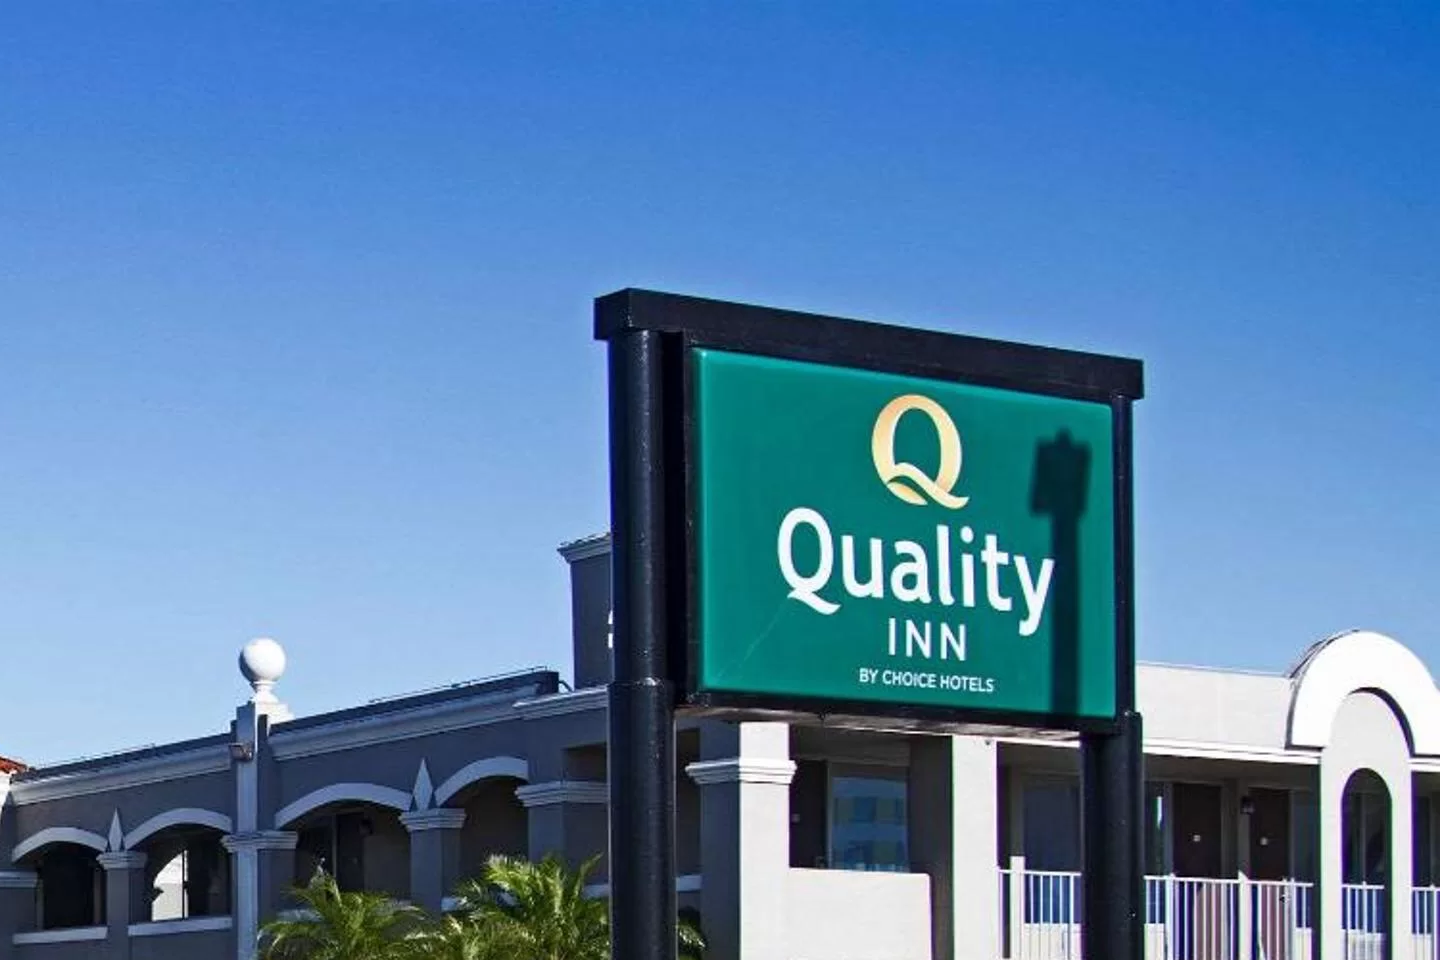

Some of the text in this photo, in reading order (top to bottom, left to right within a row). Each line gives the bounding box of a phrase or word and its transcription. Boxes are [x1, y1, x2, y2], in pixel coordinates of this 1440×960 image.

[871, 394, 969, 509] Q
[777, 506, 1055, 636] Quality
[888, 617, 966, 661] INN
[859, 667, 994, 692] BY CHOICE HOTELS
